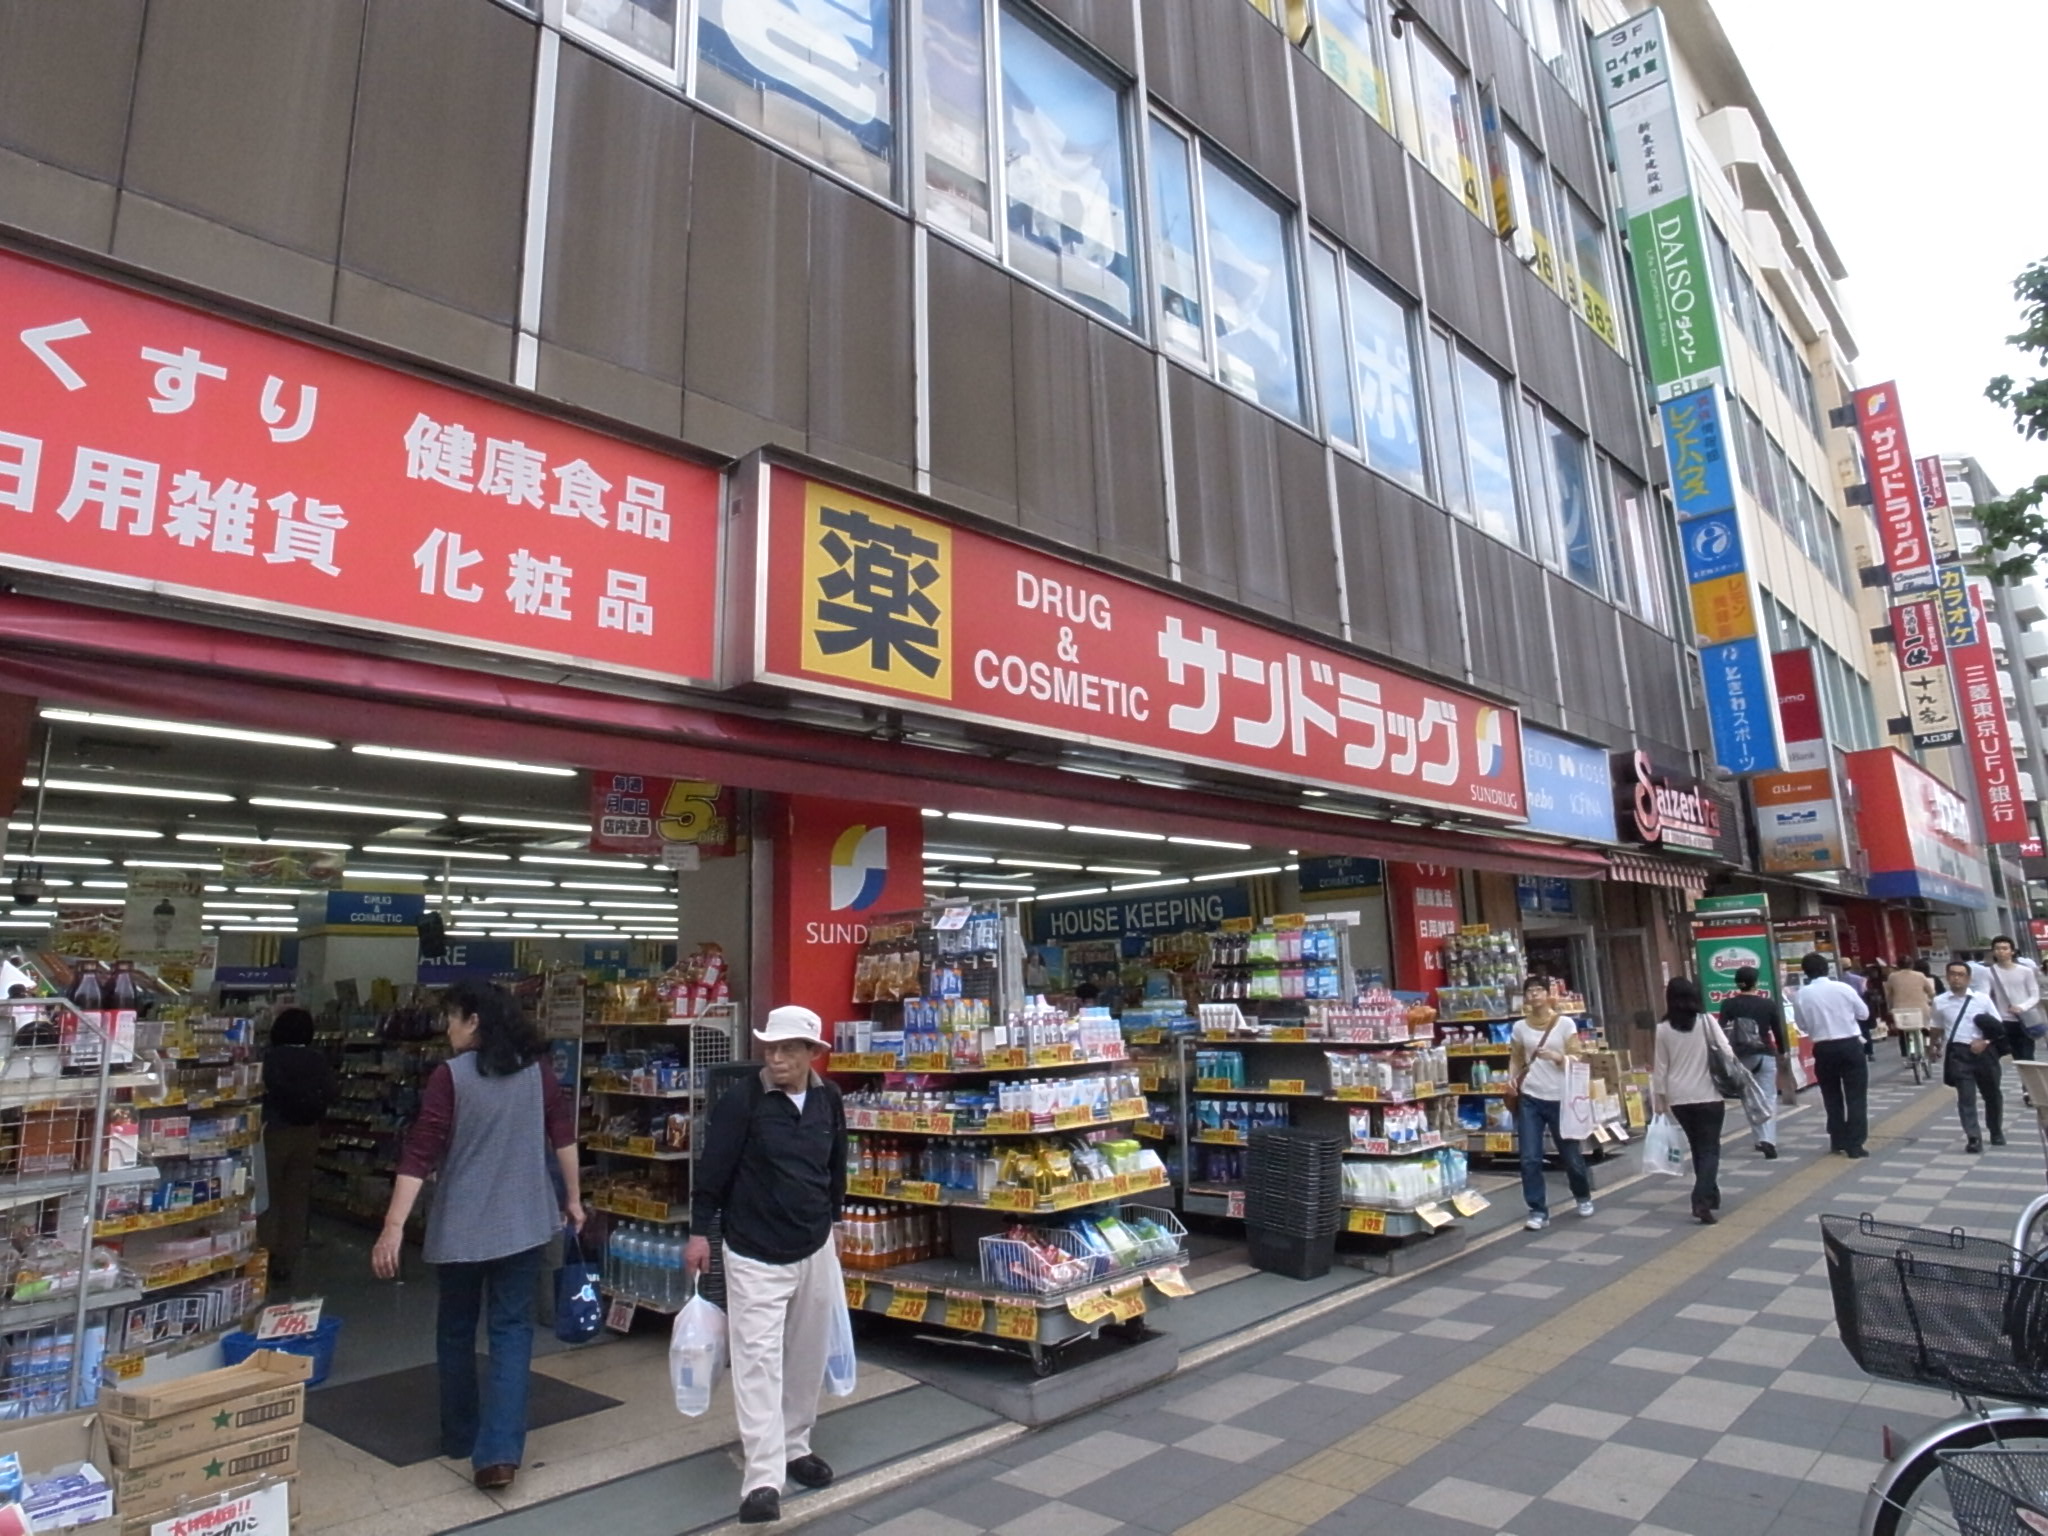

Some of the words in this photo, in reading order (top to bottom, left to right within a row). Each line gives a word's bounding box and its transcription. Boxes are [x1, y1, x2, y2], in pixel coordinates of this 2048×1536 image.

[1605, 40, 1657, 73] ロイヤル
[1658, 214, 1695, 312] DAISO
[21, 318, 319, 444] くすり
[404, 411, 673, 543] 健康食品
[1871, 426, 1921, 567] サンドラッグ
[0, 429, 349, 577] 日用雑貨
[413, 527, 655, 637] 化粧品
[813, 505, 941, 680] 薬
[1016, 569, 1112, 632] DRUG
[1941, 571, 1972, 643] カラオケ
[1057, 625, 1080, 665] &
[974, 649, 1149, 722] COSMETIC
[1157, 614, 1460, 787] サンドラッグ
[1725, 667, 1755, 771] ときわスポーツ
[1965, 664, 2015, 822] 三菱東京UFJ銀行
[655, 777, 722, 844] 5
[1470, 783, 1518, 811] SUNDRUG
[1772, 784, 1791, 795] au
[806, 922, 869, 945] SUND
[1051, 906, 1120, 937] HOUSE
[1125, 894, 1224, 930] KEEPING
